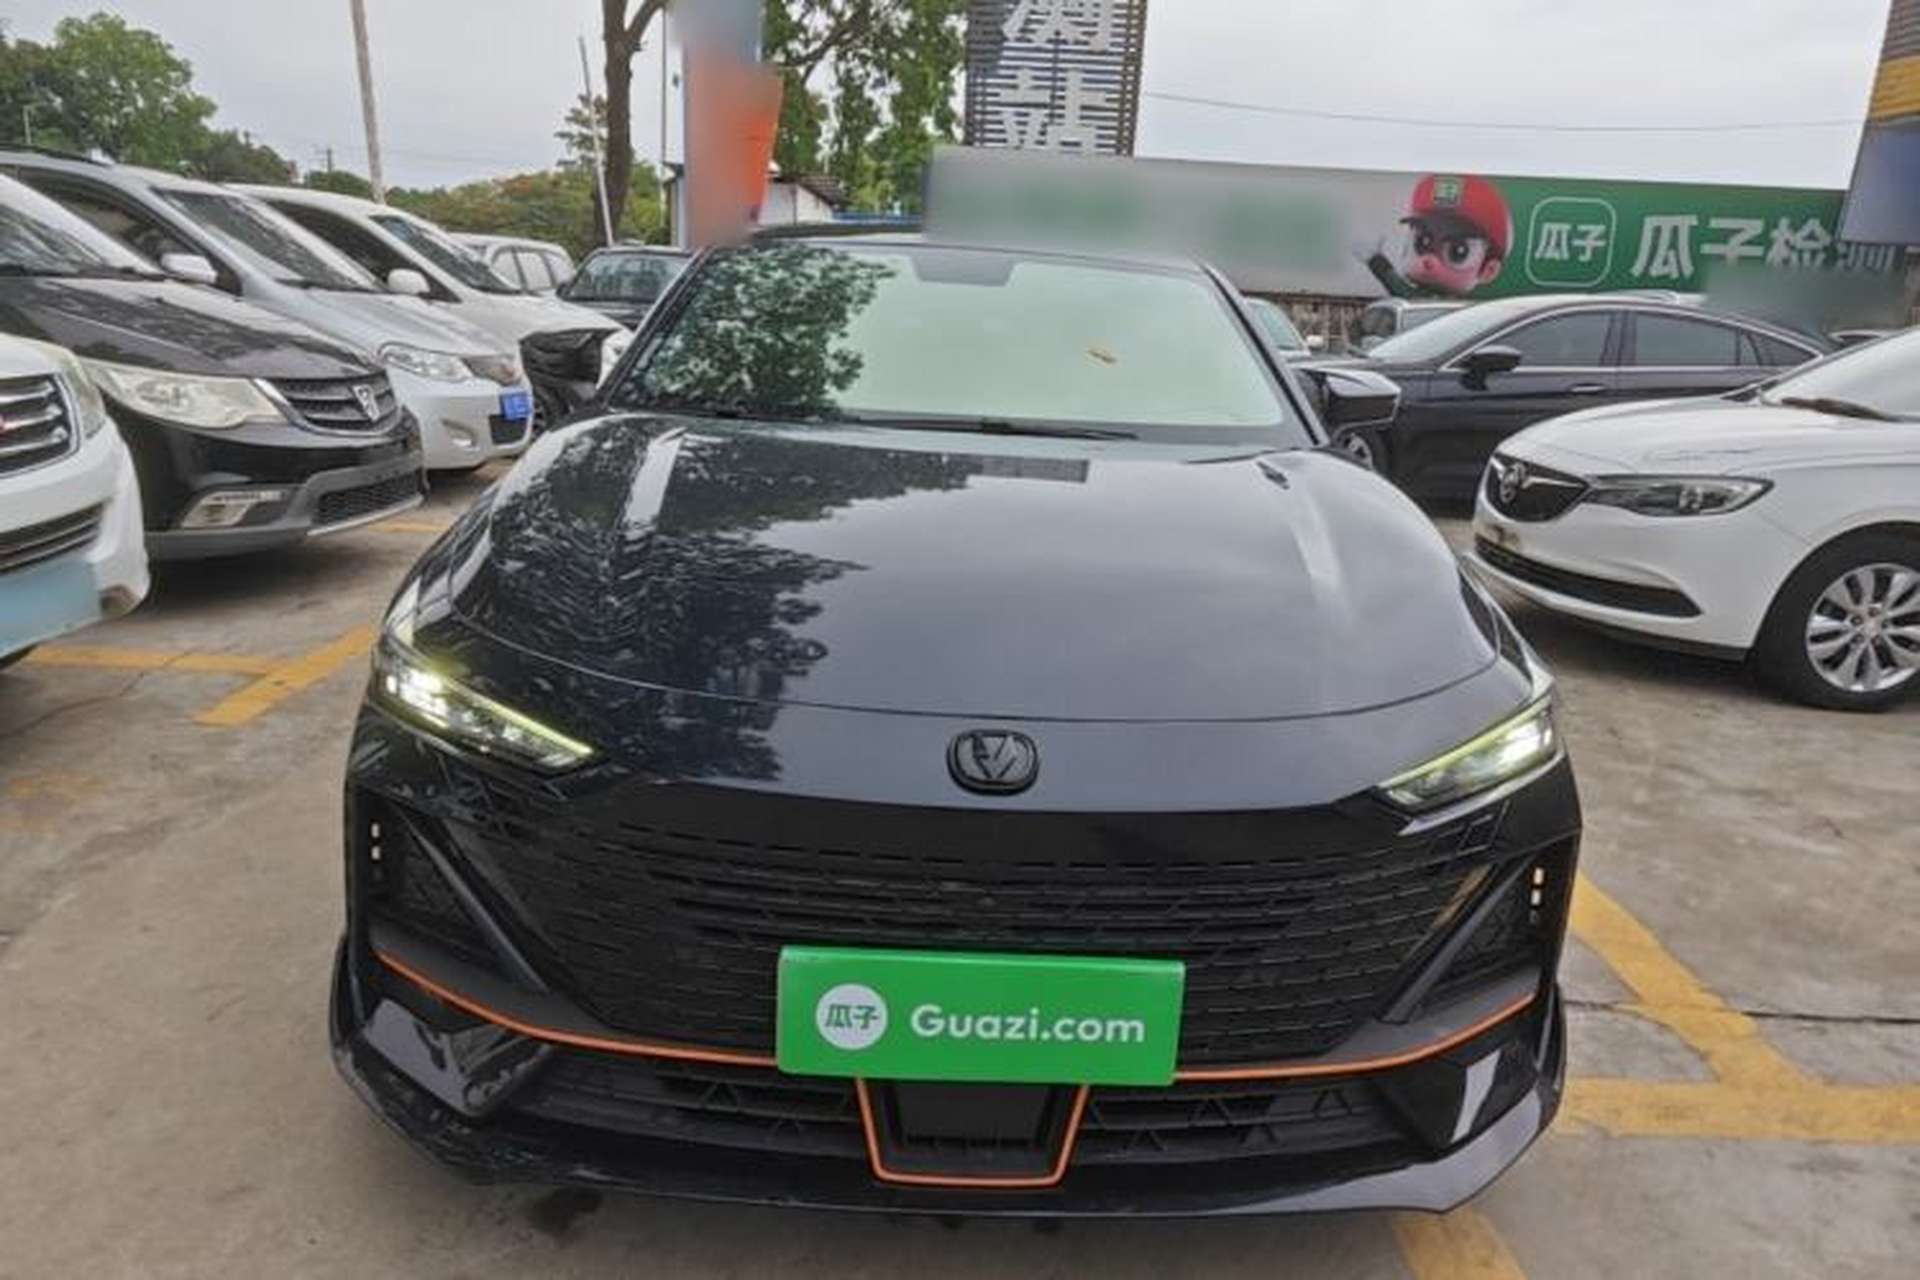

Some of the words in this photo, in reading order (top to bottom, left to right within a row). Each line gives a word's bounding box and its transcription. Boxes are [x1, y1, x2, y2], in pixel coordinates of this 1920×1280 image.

[1534, 221, 1606, 262] 瓜子
[824, 1003, 880, 1030] 瓜子
[910, 1003, 1146, 1043] Guazi.com
